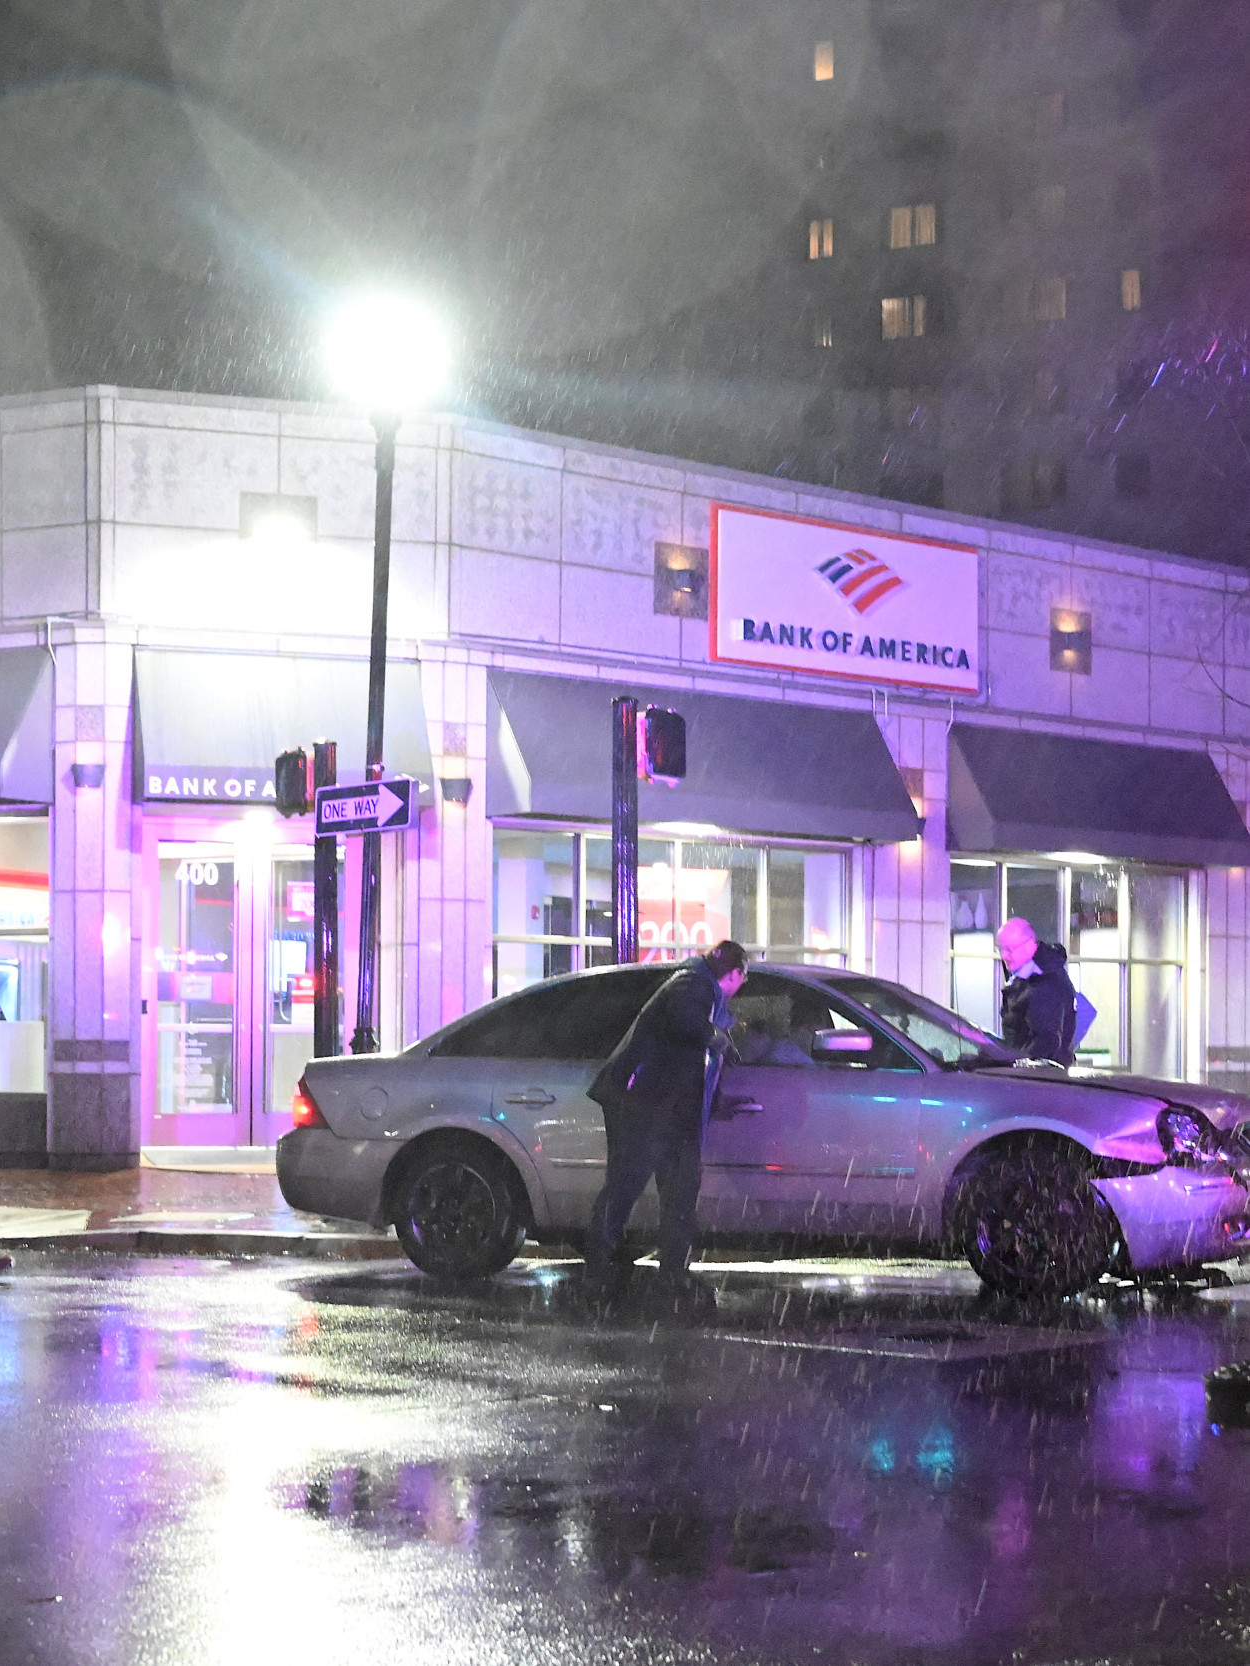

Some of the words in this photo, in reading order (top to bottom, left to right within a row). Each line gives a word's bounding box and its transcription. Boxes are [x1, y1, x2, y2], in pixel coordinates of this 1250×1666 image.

[742, 618, 814, 649] BANK
[821, 630, 853, 654] OF
[860, 635, 970, 670] AMERICA
[148, 776, 218, 796] BANK
[224, 778, 257, 797] OF
[323, 802, 348, 820] ONE
[353, 798, 380, 816] WAY
[175, 862, 219, 886] 400
